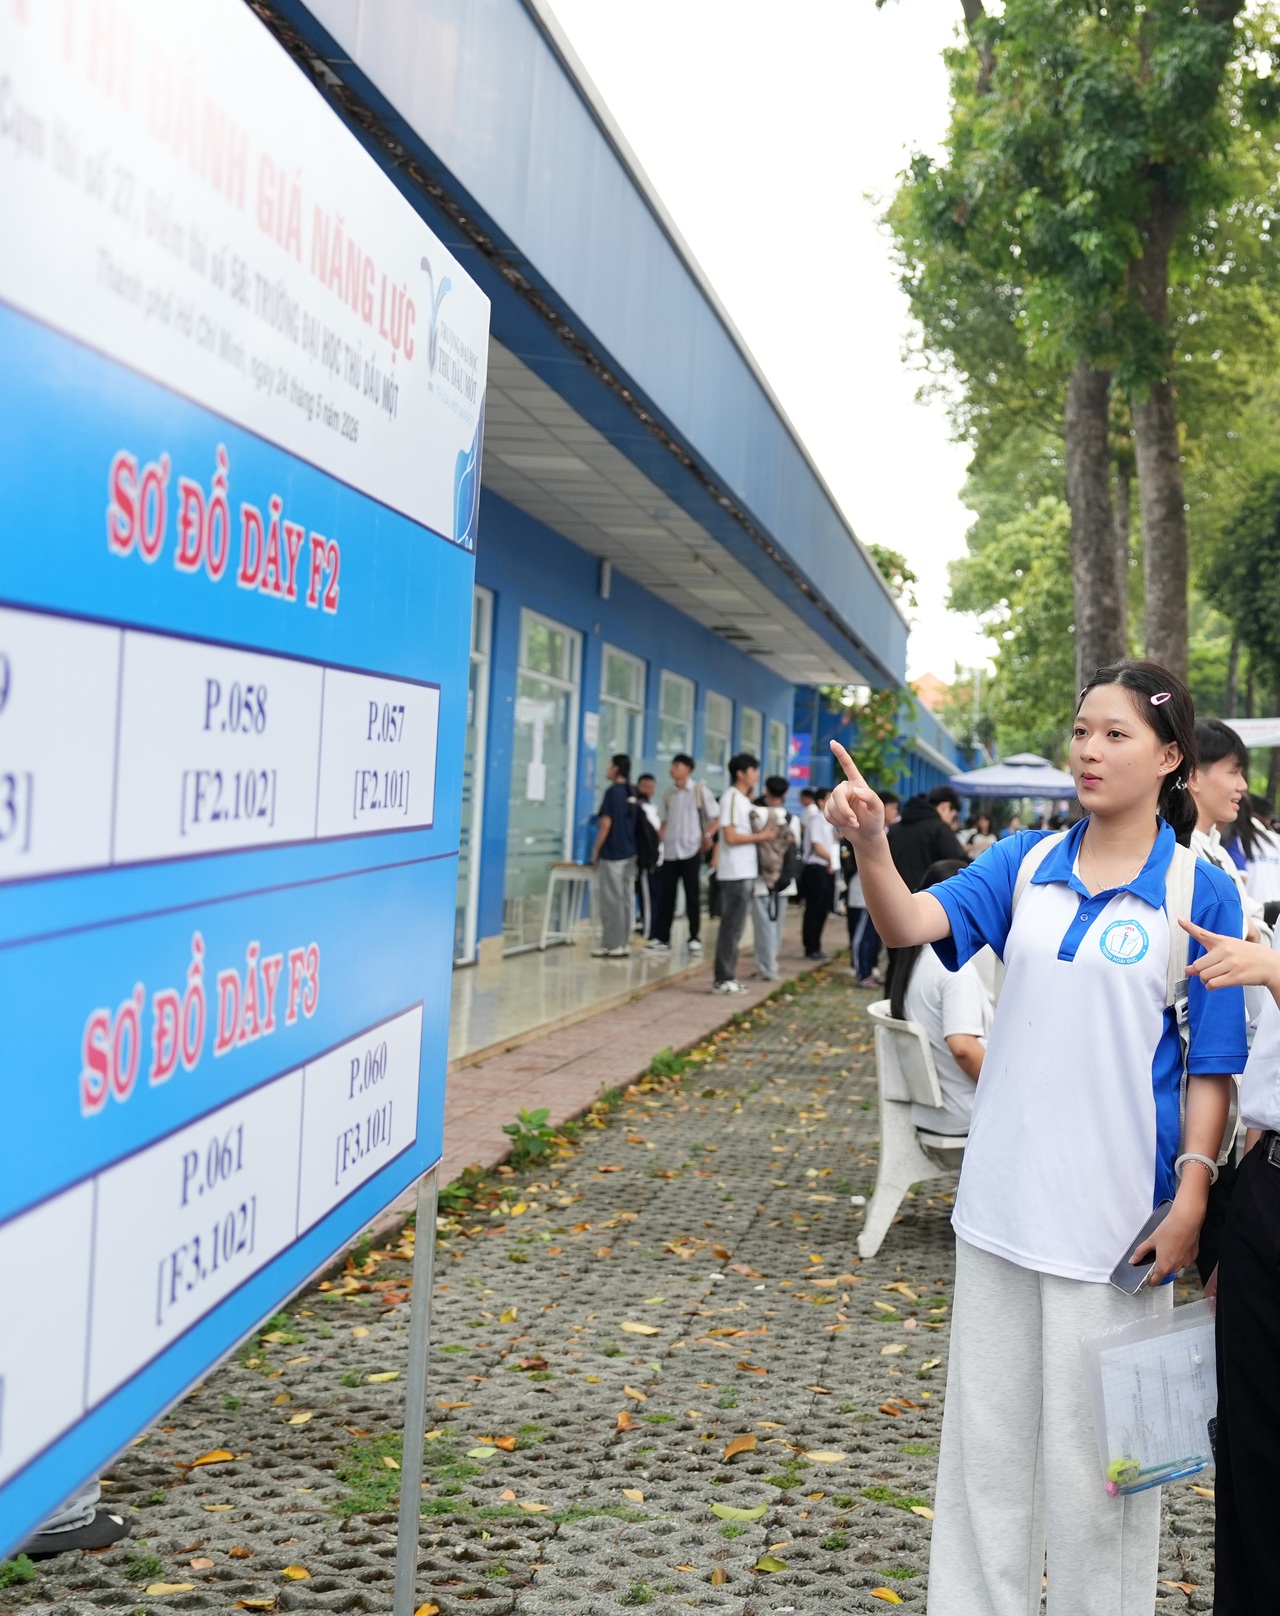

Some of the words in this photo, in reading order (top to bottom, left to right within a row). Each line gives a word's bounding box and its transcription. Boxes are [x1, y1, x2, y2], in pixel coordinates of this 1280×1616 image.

[255, 152, 304, 262] GIÁ
[310, 205, 377, 326] NĂNG
[379, 273, 416, 365] LỰC
[107, 450, 169, 562] SƠ
[175, 443, 229, 580] ĐỒ
[307, 532, 340, 613] F2
[202, 678, 268, 735] P.058
[367, 700, 405, 742] P.057
[180, 770, 277, 837] [F2.102]
[353, 770, 410, 818] [F2.101]
[80, 981, 144, 1116] SƠ
[150, 932, 204, 1086] ĐỒ
[286, 943, 319, 1024] F3
[349, 1041, 387, 1099] P.060
[180, 1123, 244, 1208] P.061
[334, 1100, 393, 1186] [F3.101]
[157, 1196, 256, 1327] [F3.102]
